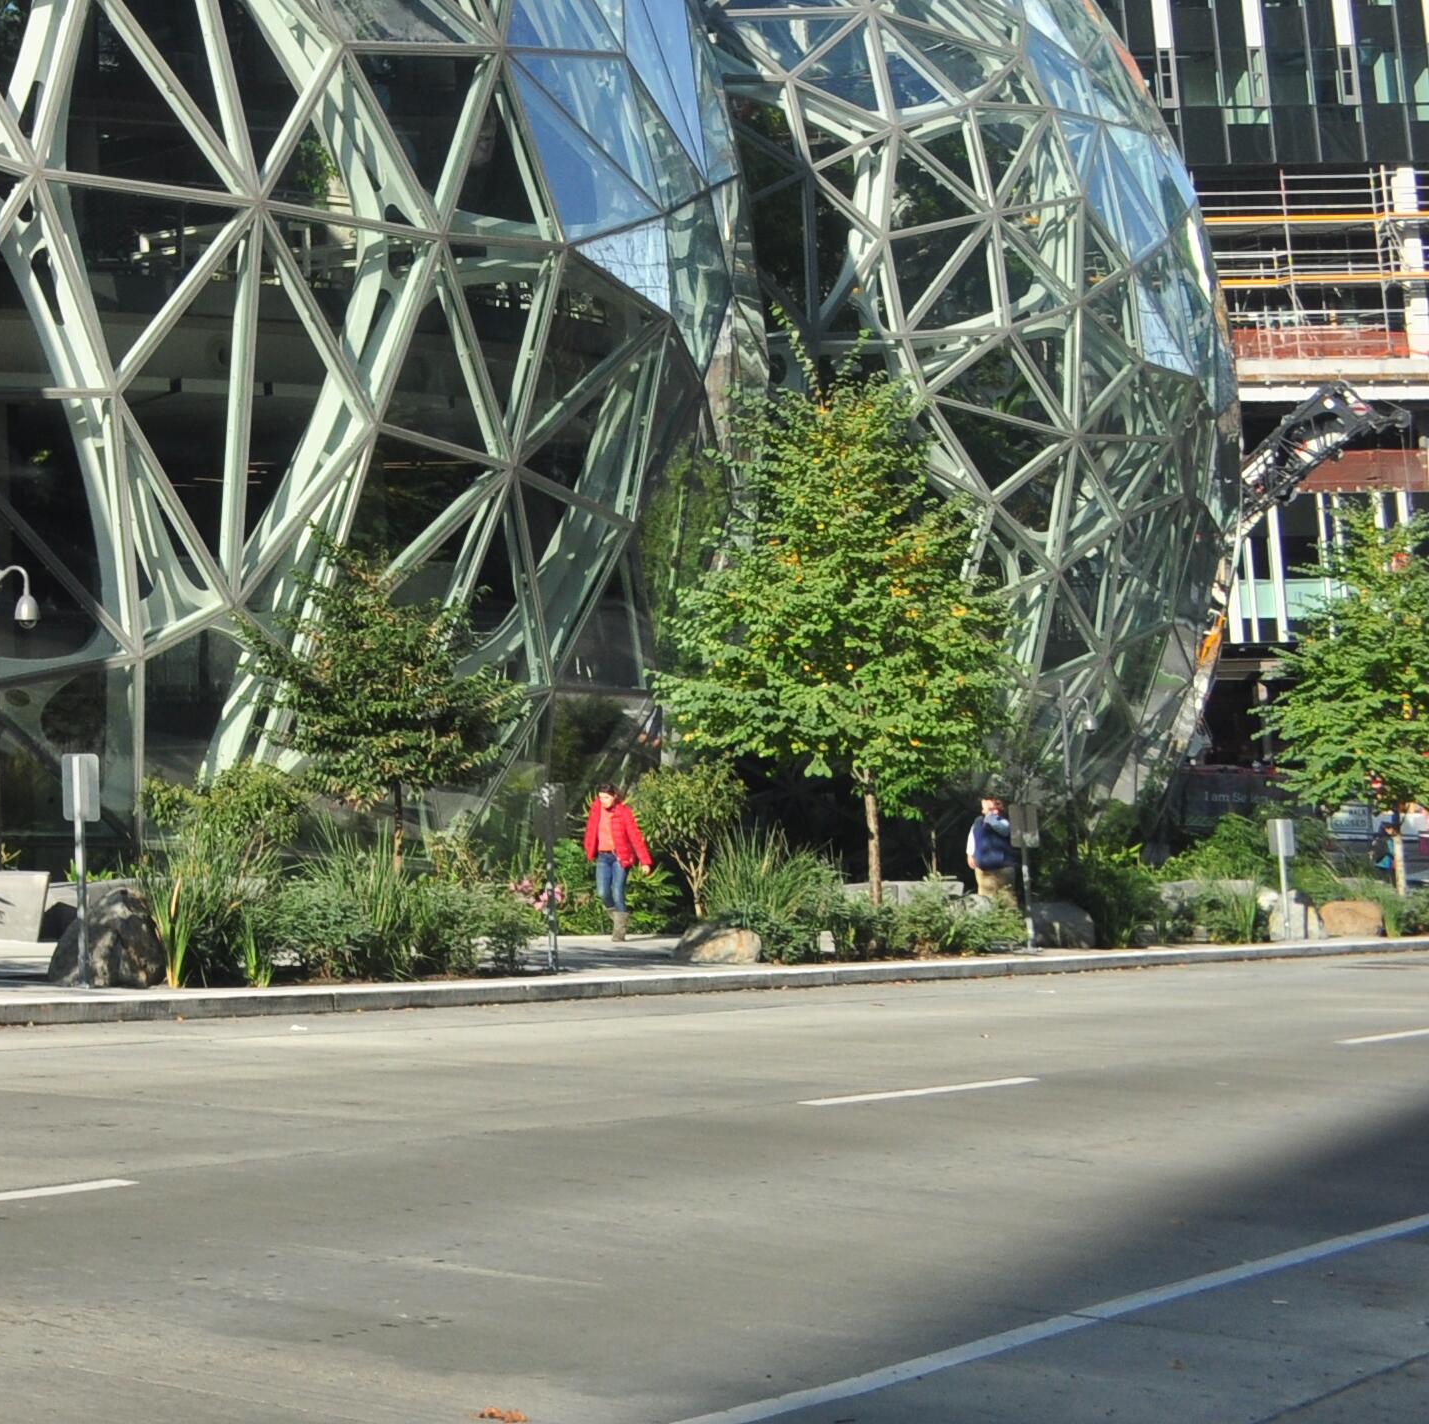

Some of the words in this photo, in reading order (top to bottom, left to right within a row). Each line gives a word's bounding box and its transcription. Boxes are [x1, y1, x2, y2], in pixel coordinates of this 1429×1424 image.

[1204, 791, 1209, 801] I
[1211, 793, 1230, 802] am
[1333, 819, 1366, 827] CLOSED
